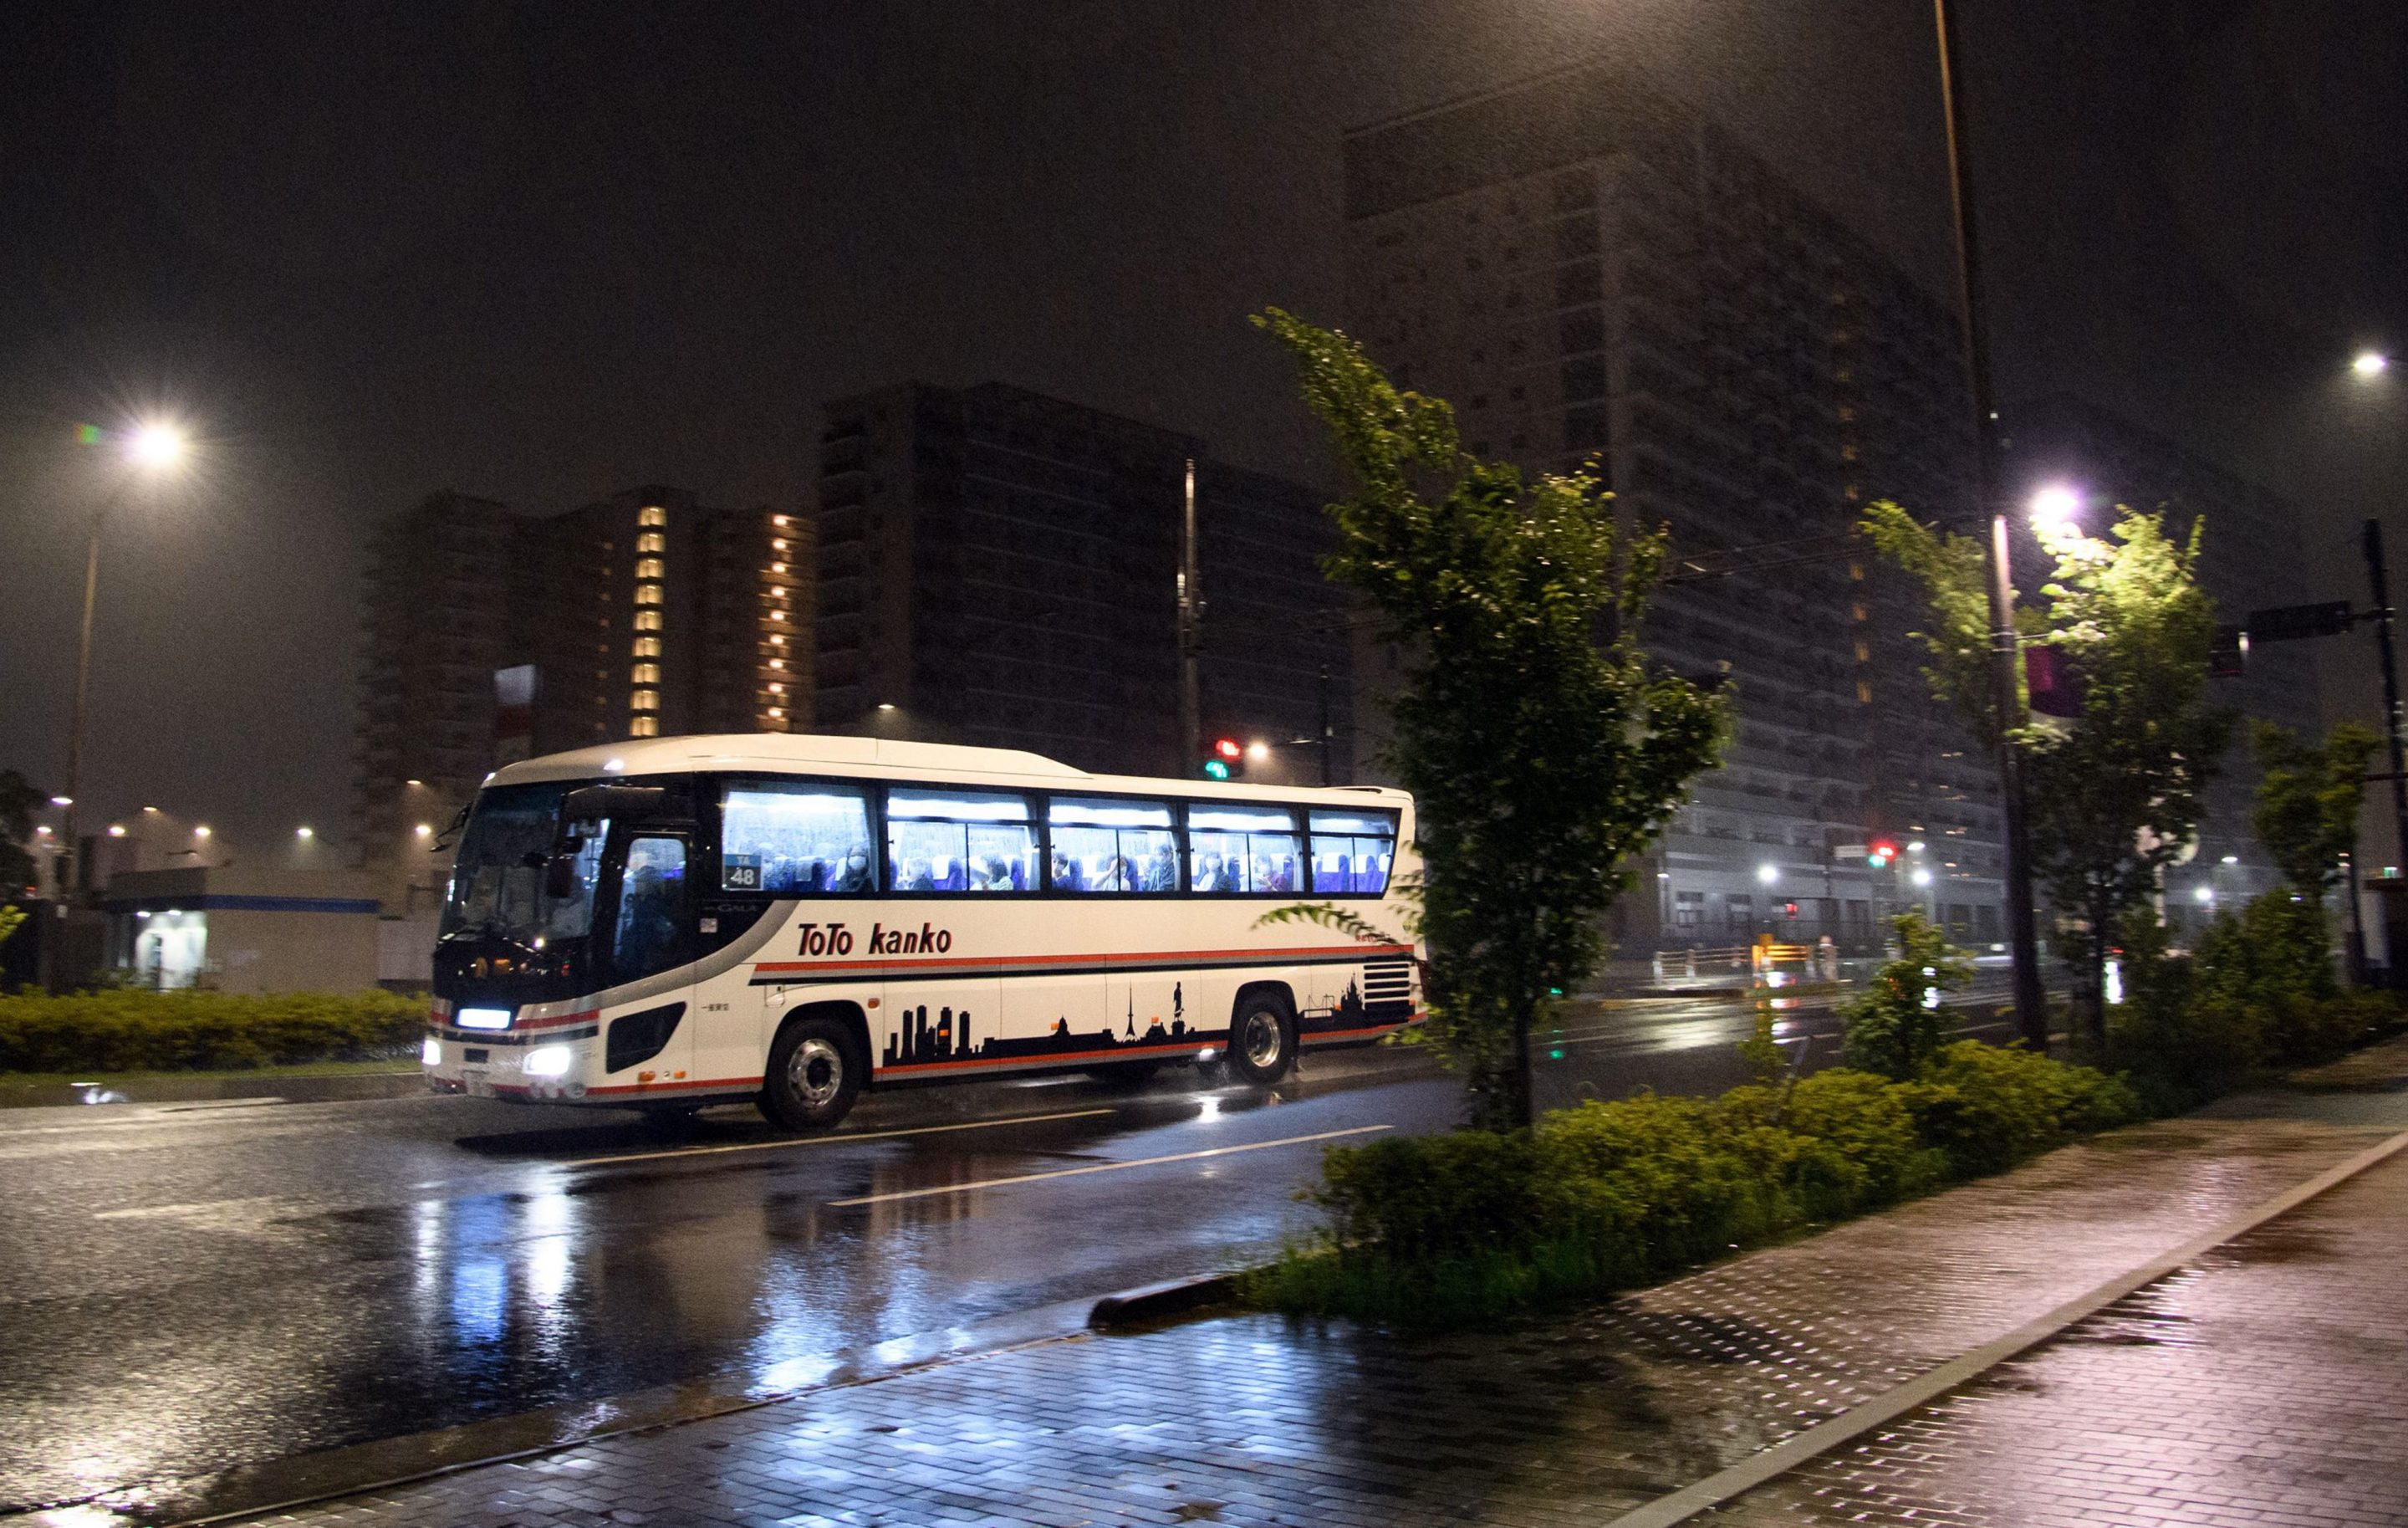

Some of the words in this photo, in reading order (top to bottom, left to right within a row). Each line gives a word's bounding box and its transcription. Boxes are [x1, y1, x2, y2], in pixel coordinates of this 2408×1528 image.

[732, 868, 754, 885] 48
[798, 923, 854, 956] ToTo
[868, 922, 952, 954] kanko
